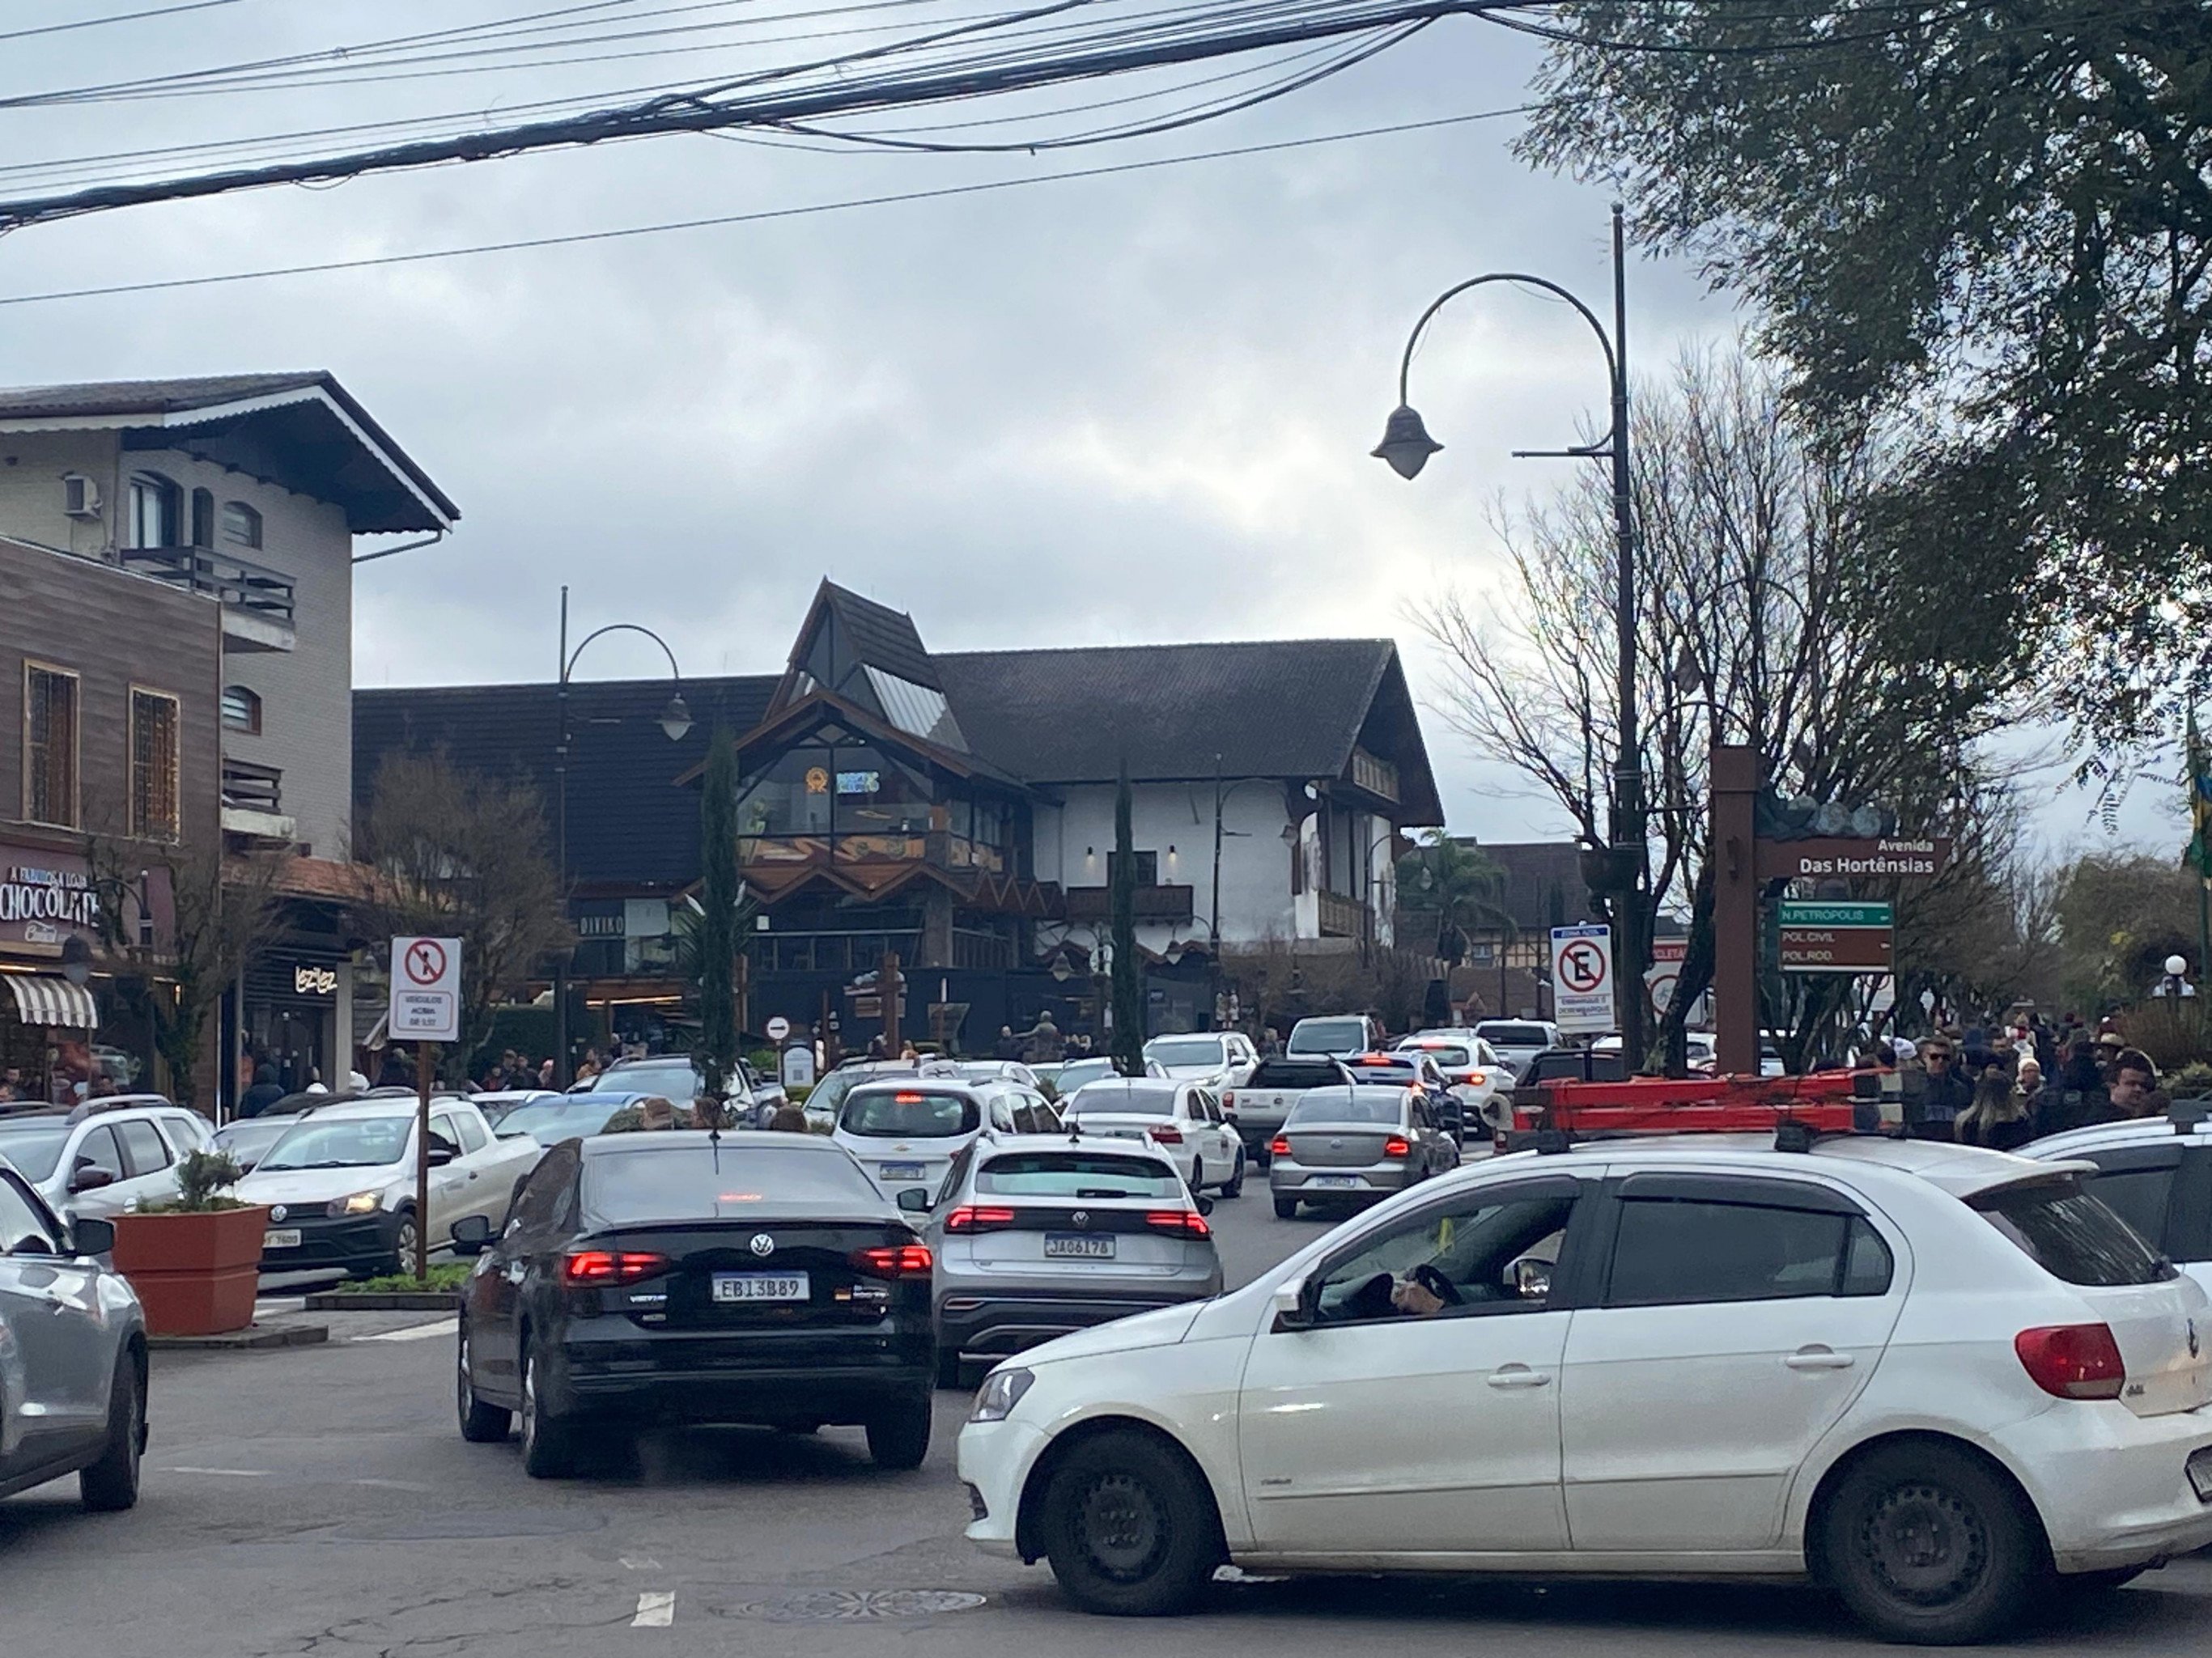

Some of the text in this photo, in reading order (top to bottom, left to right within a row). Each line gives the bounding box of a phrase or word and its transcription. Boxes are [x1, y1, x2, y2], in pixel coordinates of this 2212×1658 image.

[1878, 839, 1934, 853] Avenida
[1799, 855, 1934, 873] Das Hortênsias
